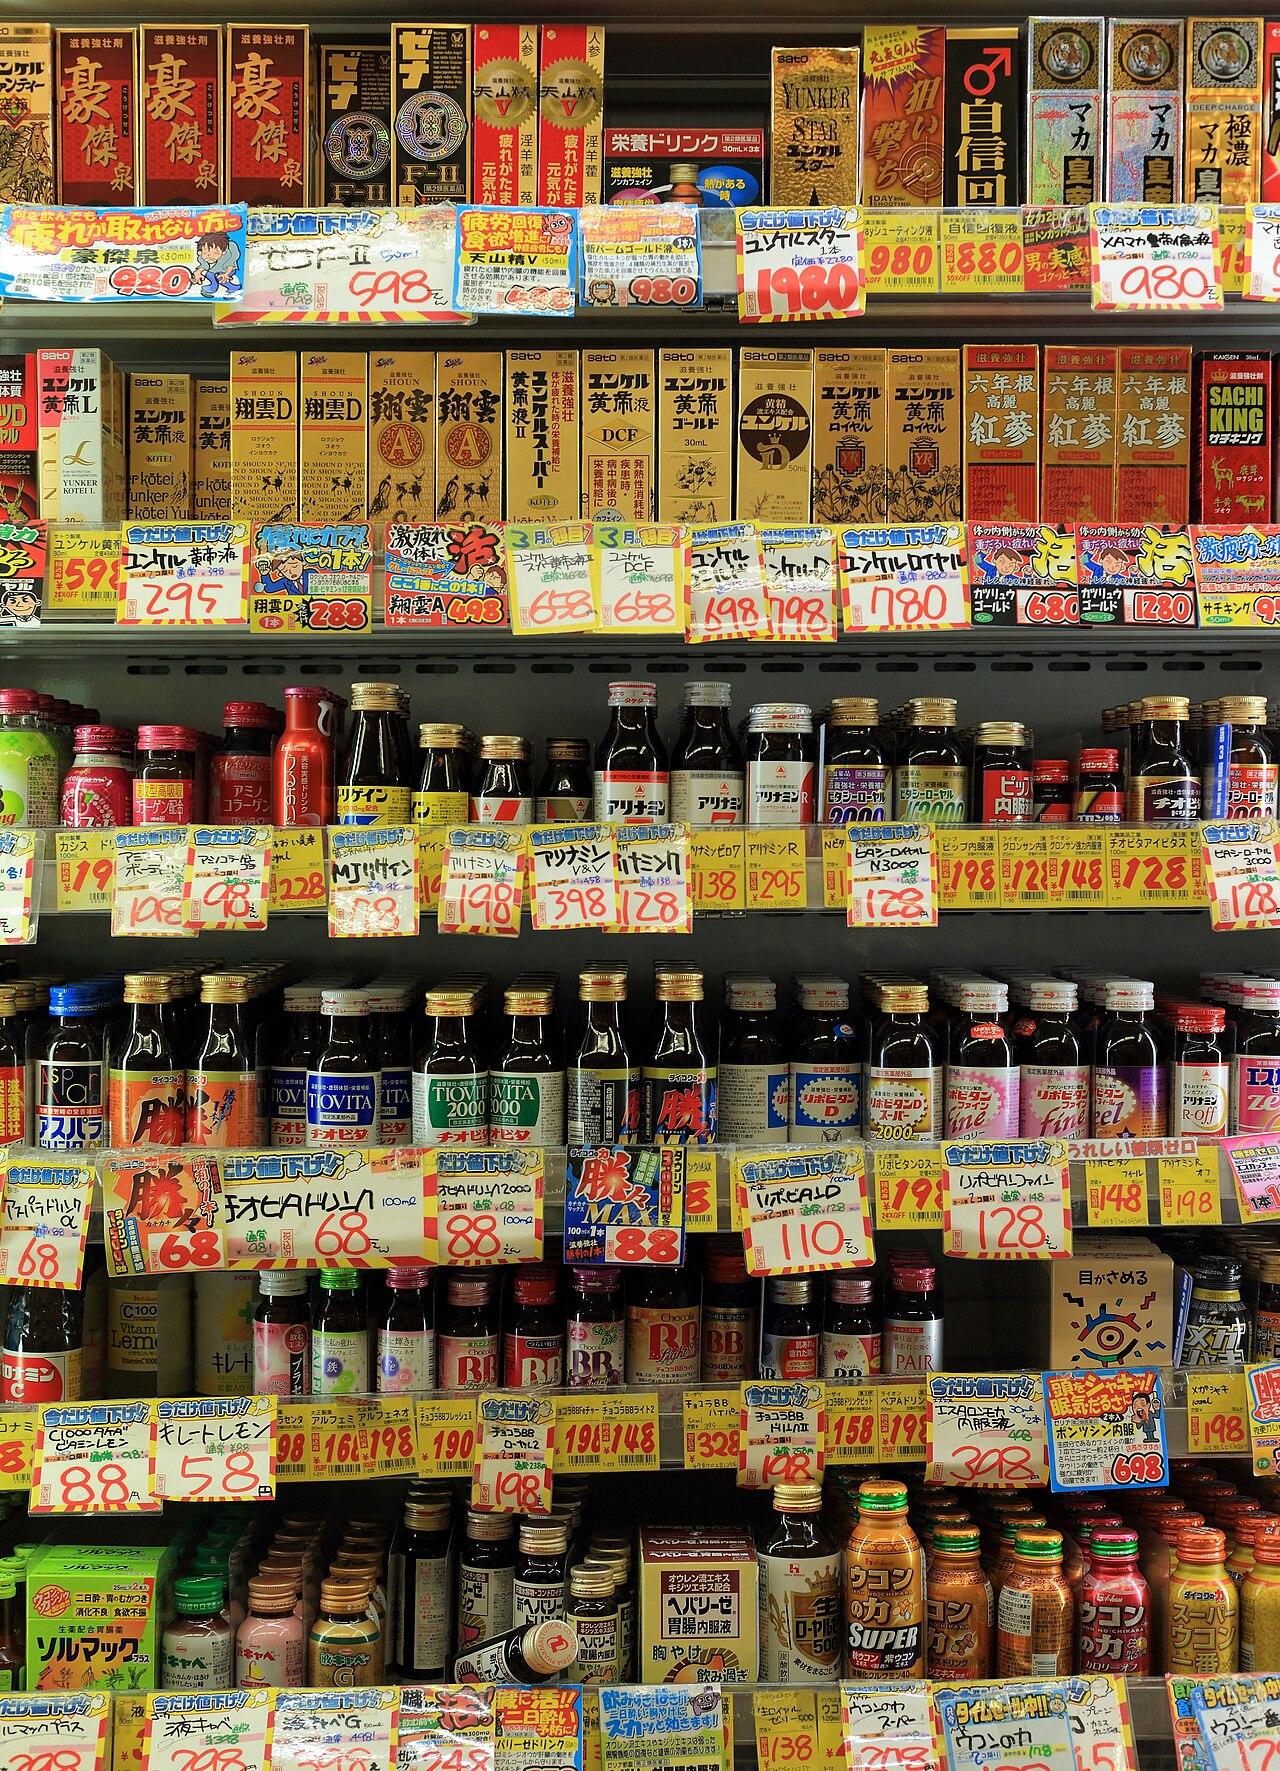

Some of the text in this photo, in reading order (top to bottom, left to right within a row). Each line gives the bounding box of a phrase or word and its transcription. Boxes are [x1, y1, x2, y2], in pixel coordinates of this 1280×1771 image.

[70, 38, 123, 49] 滋養強壮剤
[154, 36, 208, 46] 滋養強壮剤
[241, 34, 295, 45] 滋養強壮剤
[521, 32, 534, 57] 人参
[588, 32, 601, 57] 人参
[399, 30, 433, 89] ゼナ
[329, 53, 361, 109] ゼナ
[495, 99, 511, 116] V
[561, 99, 578, 116] V
[782, 83, 850, 110] YUNKER
[61, 55, 134, 191] 豪傑泉
[145, 53, 219, 189] 豪傑泉
[232, 52, 304, 187] 豪傑泉
[791, 116, 838, 142] STAR
[1068, 103, 1093, 151] マカ
[1149, 103, 1172, 151] マカ
[611, 134, 719, 152] 栄養ドリンク
[787, 145, 841, 157] ユンケル
[1225, 113, 1252, 167] 極濃
[611, 167, 652, 178] 滋養強壮
[794, 159, 834, 171] スター
[611, 178, 652, 186] ノンカフェイン
[704, 179, 745, 190] 熱がある
[12, 210, 245, 252] 疲れが取れない方に
[462, 212, 543, 231] 疲労回復
[71, 248, 160, 264] 豪傑泉
[870, 243, 932, 276] 980
[957, 243, 1022, 274] 880
[109, 266, 191, 296] 980
[348, 270, 432, 306] 598
[630, 277, 696, 304] 980
[758, 265, 859, 314] 1980
[1121, 265, 1209, 300] 980
[53, 365, 85, 374] 滋養強壮
[588, 372, 650, 389] ユンケル
[1230, 372, 1263, 381] 滋養強壮剤
[43, 377, 97, 392] ユンケル
[383, 378, 420, 386] SHOUN
[451, 378, 487, 386] SHOUN
[664, 378, 727, 391] ユンケル
[895, 387, 955, 400] ユンケル
[969, 373, 1036, 394] 六年根
[1049, 375, 1115, 395] 六年根
[43, 394, 98, 414] 黄帝L
[370, 388, 433, 423] 翔雲
[438, 388, 500, 423] 翔雲
[562, 371, 574, 422] 滋養強壮
[673, 393, 718, 416] 黄帝
[986, 394, 1018, 409] 高麗
[1139, 396, 1170, 411] 高麗
[1210, 386, 1263, 406] SACHI
[134, 409, 186, 423] ユンケル
[235, 397, 292, 420] 翔雲D
[304, 396, 362, 421] 翔雲D
[1210, 408, 1264, 432] KING
[134, 425, 186, 445] 黄帝液
[531, 370, 549, 488] ユンケルスーパー
[603, 428, 638, 441] DCF
[673, 417, 719, 431] ゴールド
[742, 416, 809, 431] ユンケル
[829, 422, 873, 433] ロイヤル
[902, 422, 946, 434] ロイヤル
[684, 438, 707, 447] 30mL
[1209, 434, 1262, 444] サチキング
[147, 455, 172, 463] KOTEI
[593, 459, 604, 507] 栄養補給に
[607, 459, 617, 507] 病中病後の
[634, 459, 644, 519] 発熱性消耗性
[402, 547, 446, 560] の体に
[143, 583, 224, 621] 295
[389, 596, 445, 615] 翔雲A
[528, 590, 592, 619] 658
[871, 584, 947, 623] 780
[974, 588, 1015, 600] カツリュウ
[1080, 588, 1122, 600] カツリュウ
[448, 598, 503, 624] 498
[704, 595, 759, 631] 698
[770, 596, 829, 636] 798
[974, 600, 1011, 612] ゴールド
[1081, 600, 1118, 612] ゴールド
[1135, 592, 1190, 621] 1280
[1204, 602, 1251, 615] サチキング
[233, 785, 262, 798] アミノ
[755, 791, 799, 803] アリナミン
[607, 799, 666, 816] アリナミン
[60, 840, 89, 852] カシス
[1110, 837, 1187, 849] チオビタアイビタス
[535, 845, 611, 868] アリナミン
[759, 870, 804, 899] 295
[950, 859, 996, 892] 198
[1057, 858, 1103, 889] 148
[1122, 856, 1188, 890] 128
[279, 876, 326, 900] 228
[203, 882, 251, 918] 98
[459, 882, 513, 924] 198
[547, 887, 607, 921] 398
[622, 890, 679, 925] 128
[803, 1093, 855, 1104] リポビタン
[1183, 1096, 1218, 1106] アリナミン
[824, 1106, 840, 1116] D
[879, 1110, 909, 1121] スーパー
[1041, 1105, 1087, 1136] fine
[39, 1116, 102, 1138] アスパラ
[310, 1128, 369, 1141] チオビタ
[1100, 1184, 1142, 1213] 148
[1176, 1192, 1213, 1217] 198
[314, 1211, 371, 1256] 68
[446, 1214, 501, 1258] 88
[979, 1205, 1046, 1249] 128
[159, 1230, 221, 1269] 68
[782, 1220, 844, 1260] 110
[18, 1236, 58, 1278] 68
[1079, 1270, 1147, 1285] 目がさめる
[896, 1354, 934, 1372] PAIR
[358, 1409, 409, 1422] アルフェネオ
[159, 1425, 270, 1445] キレートレモン
[611, 1422, 656, 1454] 148
[833, 1414, 873, 1445] 158
[1204, 1414, 1245, 1443] 198
[370, 1425, 413, 1460] 198
[433, 1429, 474, 1460] 190
[697, 1430, 740, 1459] 328
[181, 1455, 260, 1494] 58
[950, 1445, 1032, 1481] 398
[1114, 1455, 1163, 1482] 698
[60, 1463, 129, 1504] 88
[75, 1608, 147, 1618] 消化不良 食欲不振
[668, 1596, 733, 1615] ヘパリーゼ
[1080, 1605, 1146, 1627] ウコン
[1172, 1605, 1236, 1624] スーパー
[58, 1625, 124, 1634] 生薬配合胃腸薬
[668, 1617, 732, 1634] 胃腸内服液
[850, 1626, 918, 1650] SUPER
[1171, 1628, 1237, 1650] ウコン
[37, 1637, 139, 1663] ソルマック
[652, 1644, 703, 1661] 胸やけ
[1086, 1662, 1137, 1672] カロリーオフ
[771, 1734, 814, 1762] 138
